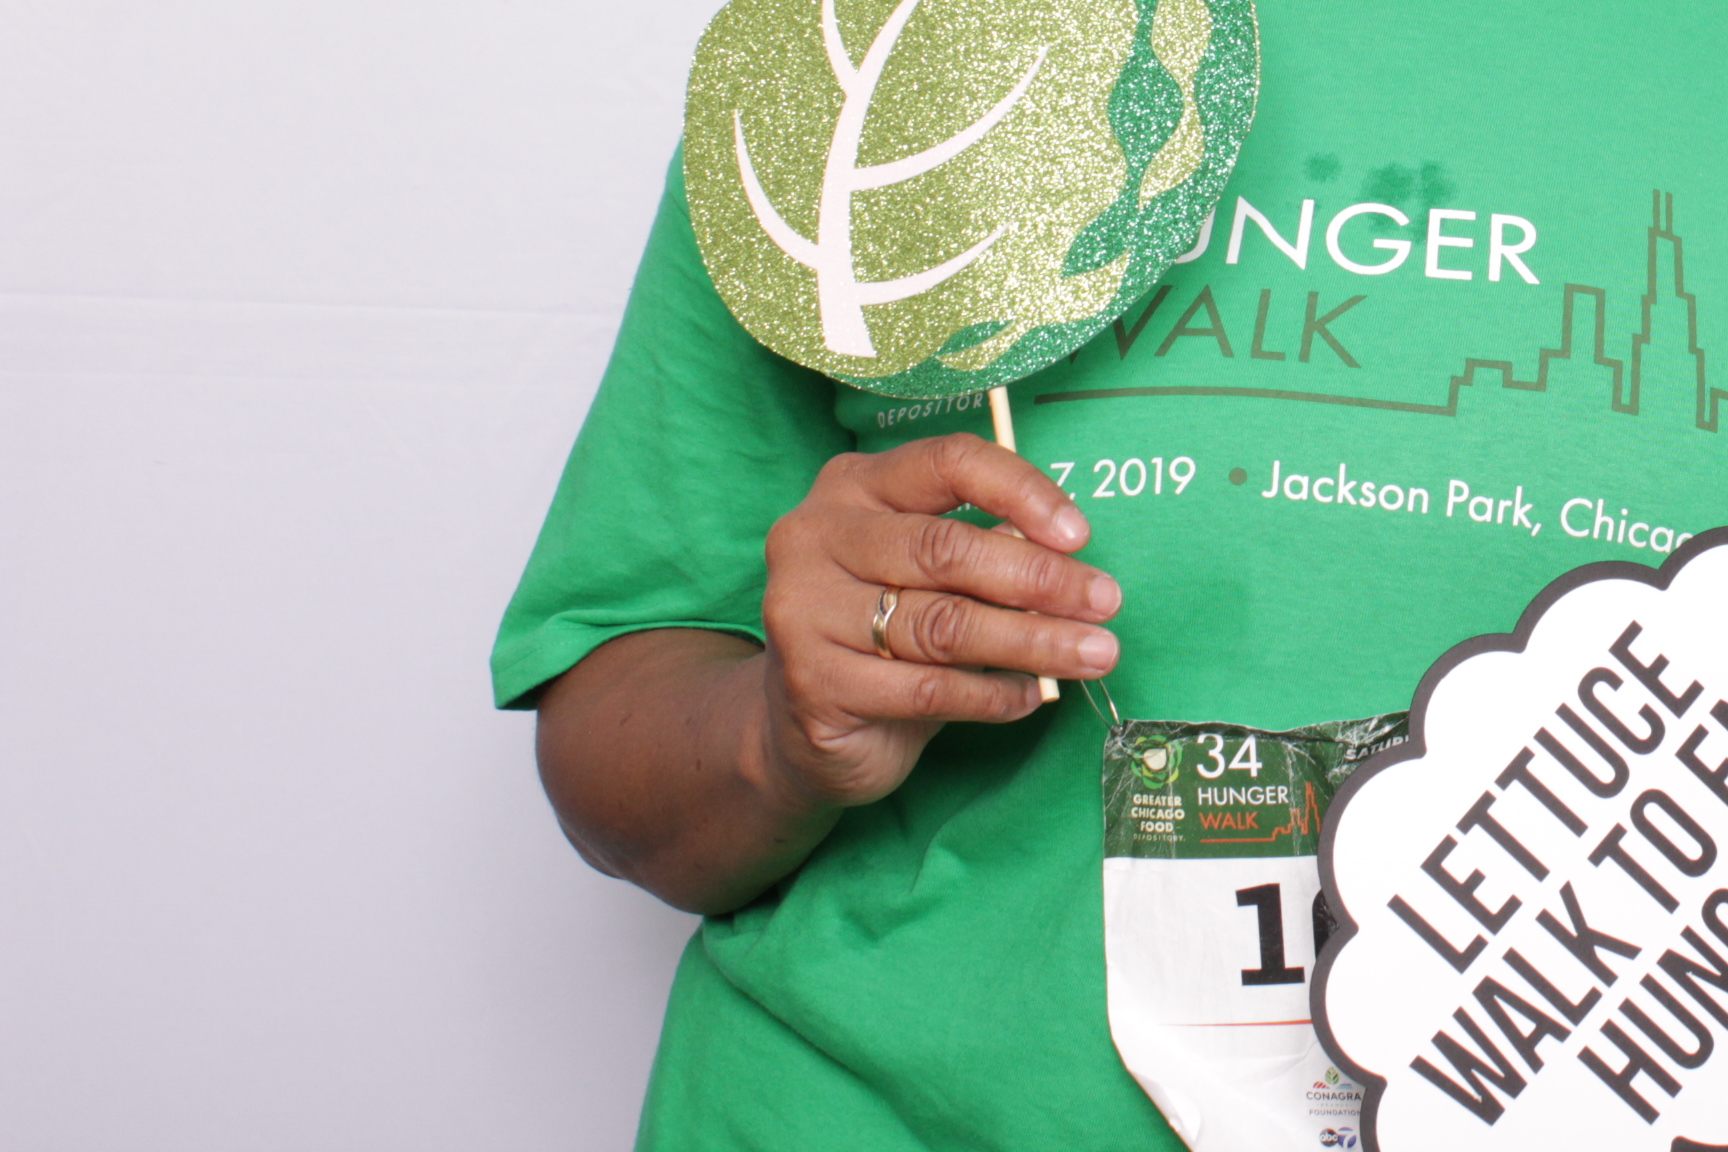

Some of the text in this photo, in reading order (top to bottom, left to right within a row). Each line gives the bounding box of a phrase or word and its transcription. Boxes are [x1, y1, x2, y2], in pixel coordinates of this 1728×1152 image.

[877, 392, 992, 429] DEPOSITOR
[1091, 456, 1197, 498] 2019
[1261, 460, 1430, 515] Jackson
[1445, 479, 1542, 537] Park,
[1196, 732, 1263, 780] 34
[1132, 793, 1183, 807] GREATER
[1197, 785, 1289, 806] HUNGER
[1387, 620, 1704, 974] LETTUCE
[1130, 806, 1186, 821] CHICAGO
[1198, 811, 1260, 831] WALK
[1139, 820, 1175, 833] FOOD
[1409, 881, 1642, 1126] WALK
[1588, 789, 1718, 914] TO
[1306, 1091, 1361, 1101] CONAGRA
[1320, 1131, 1339, 1142] abc
